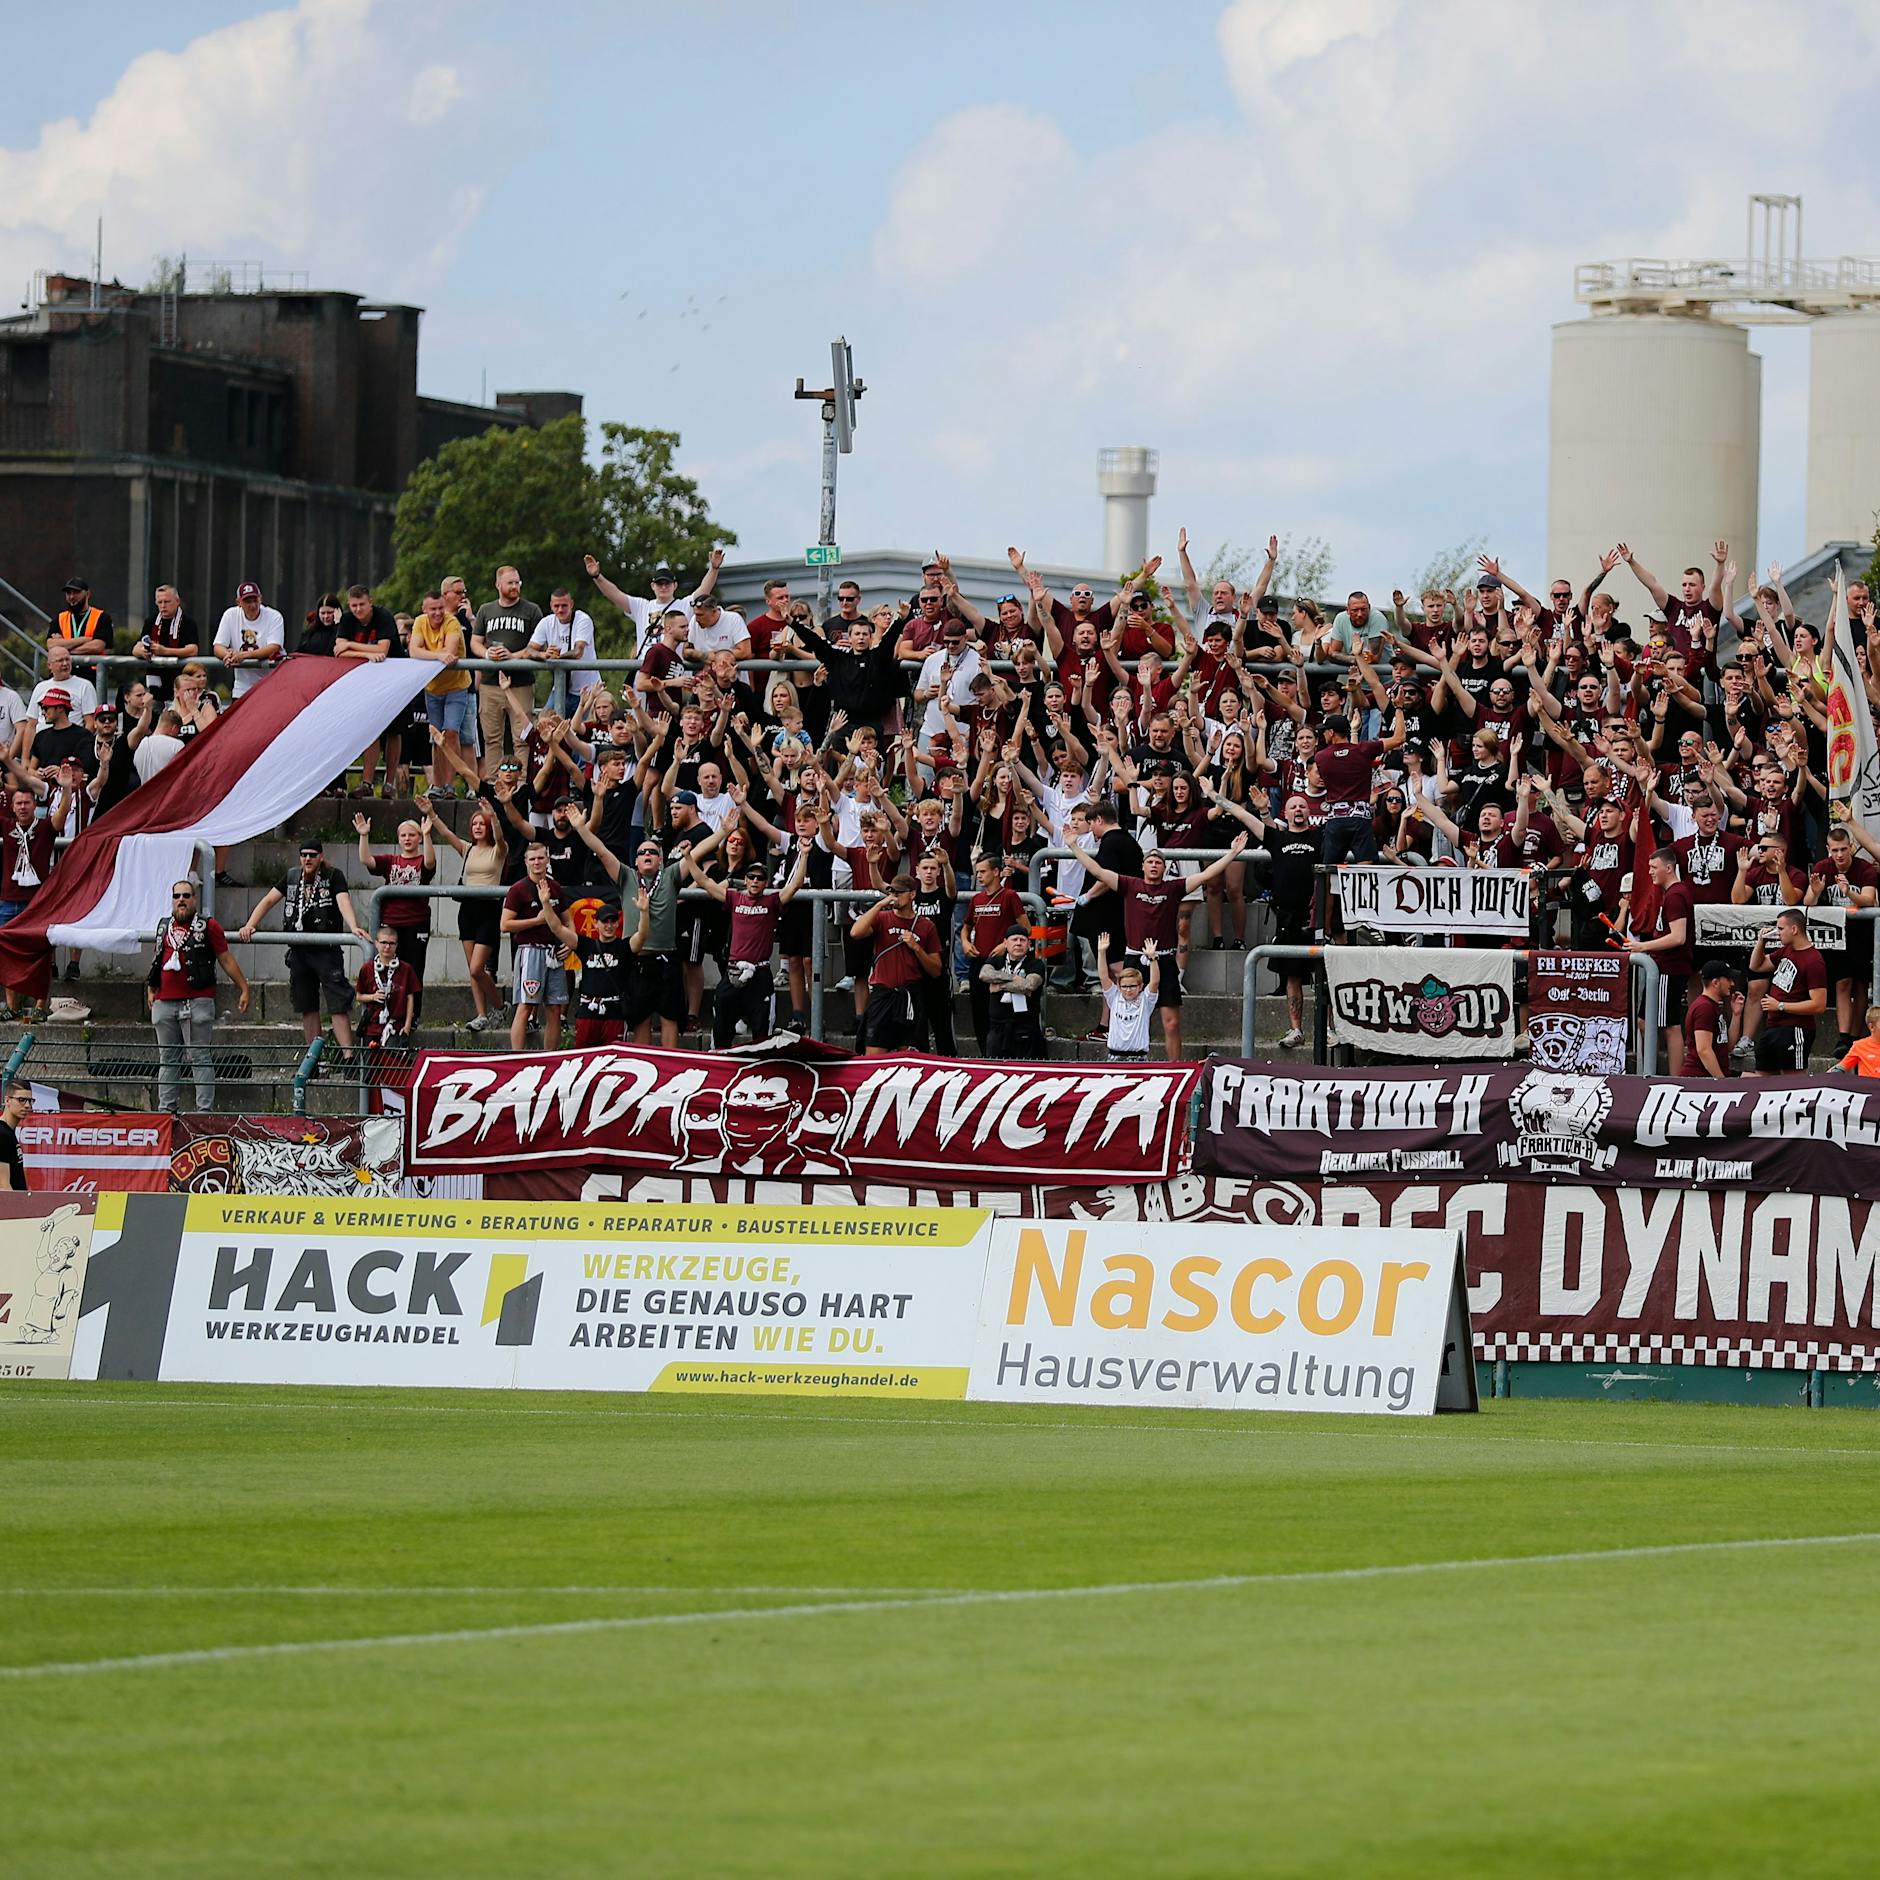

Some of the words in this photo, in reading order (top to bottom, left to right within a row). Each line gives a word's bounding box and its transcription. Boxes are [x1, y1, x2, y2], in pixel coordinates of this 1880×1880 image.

[487, 617, 525, 634] MAYHEM
[1340, 872, 1379, 916] FICK
[1387, 871, 1459, 917] DICH
[1537, 957, 1556, 971] FH
[1561, 957, 1620, 973] PIEFKES
[1529, 1018, 1579, 1039] BFC
[420, 1057, 703, 1150] BANDA
[841, 1066, 1174, 1153] INVICTA
[1206, 1064, 1497, 1138] FRAKTION-H
[1634, 1084, 1747, 1147] OST
[1748, 1086, 1880, 1151] BERL
[56, 1127, 160, 1147] MEISTER
[170, 1138, 231, 1183] BFC
[1319, 1150, 1390, 1174] BERLINER
[1391, 1148, 1465, 1172] FUSSBALL
[1654, 1158, 1694, 1179] CLUB
[1695, 1156, 1753, 1182] DYNAMO
[1168, 1175, 1300, 1227] BFC
[221, 1209, 306, 1226] VERKAUF
[313, 1212, 326, 1225] &
[334, 1211, 458, 1229] VERMIETUNG
[480, 1214, 580, 1232] BERATUNG
[602, 1216, 714, 1234] REPARATUR
[736, 1218, 940, 1237] BAUSTELLENSERVICE
[582, 1253, 802, 1286] WERKZEUGE,
[1538, 1184, 1880, 1328] DYNAM
[207, 1246, 473, 1315] HACK
[1004, 1227, 1432, 1337] Nascor
[575, 1287, 631, 1314] DIE
[643, 1289, 807, 1318] GENAUSO
[819, 1292, 914, 1320] HART
[205, 1321, 461, 1345] WERKZEUGHANDEL
[568, 1322, 739, 1351] ARBEITEN
[752, 1325, 817, 1352] WIE
[827, 1327, 885, 1354] DU.
[675, 1369, 919, 1389] www.hack-werkzeughandel.de
[995, 1341, 1416, 1411] Hausverwaltung
